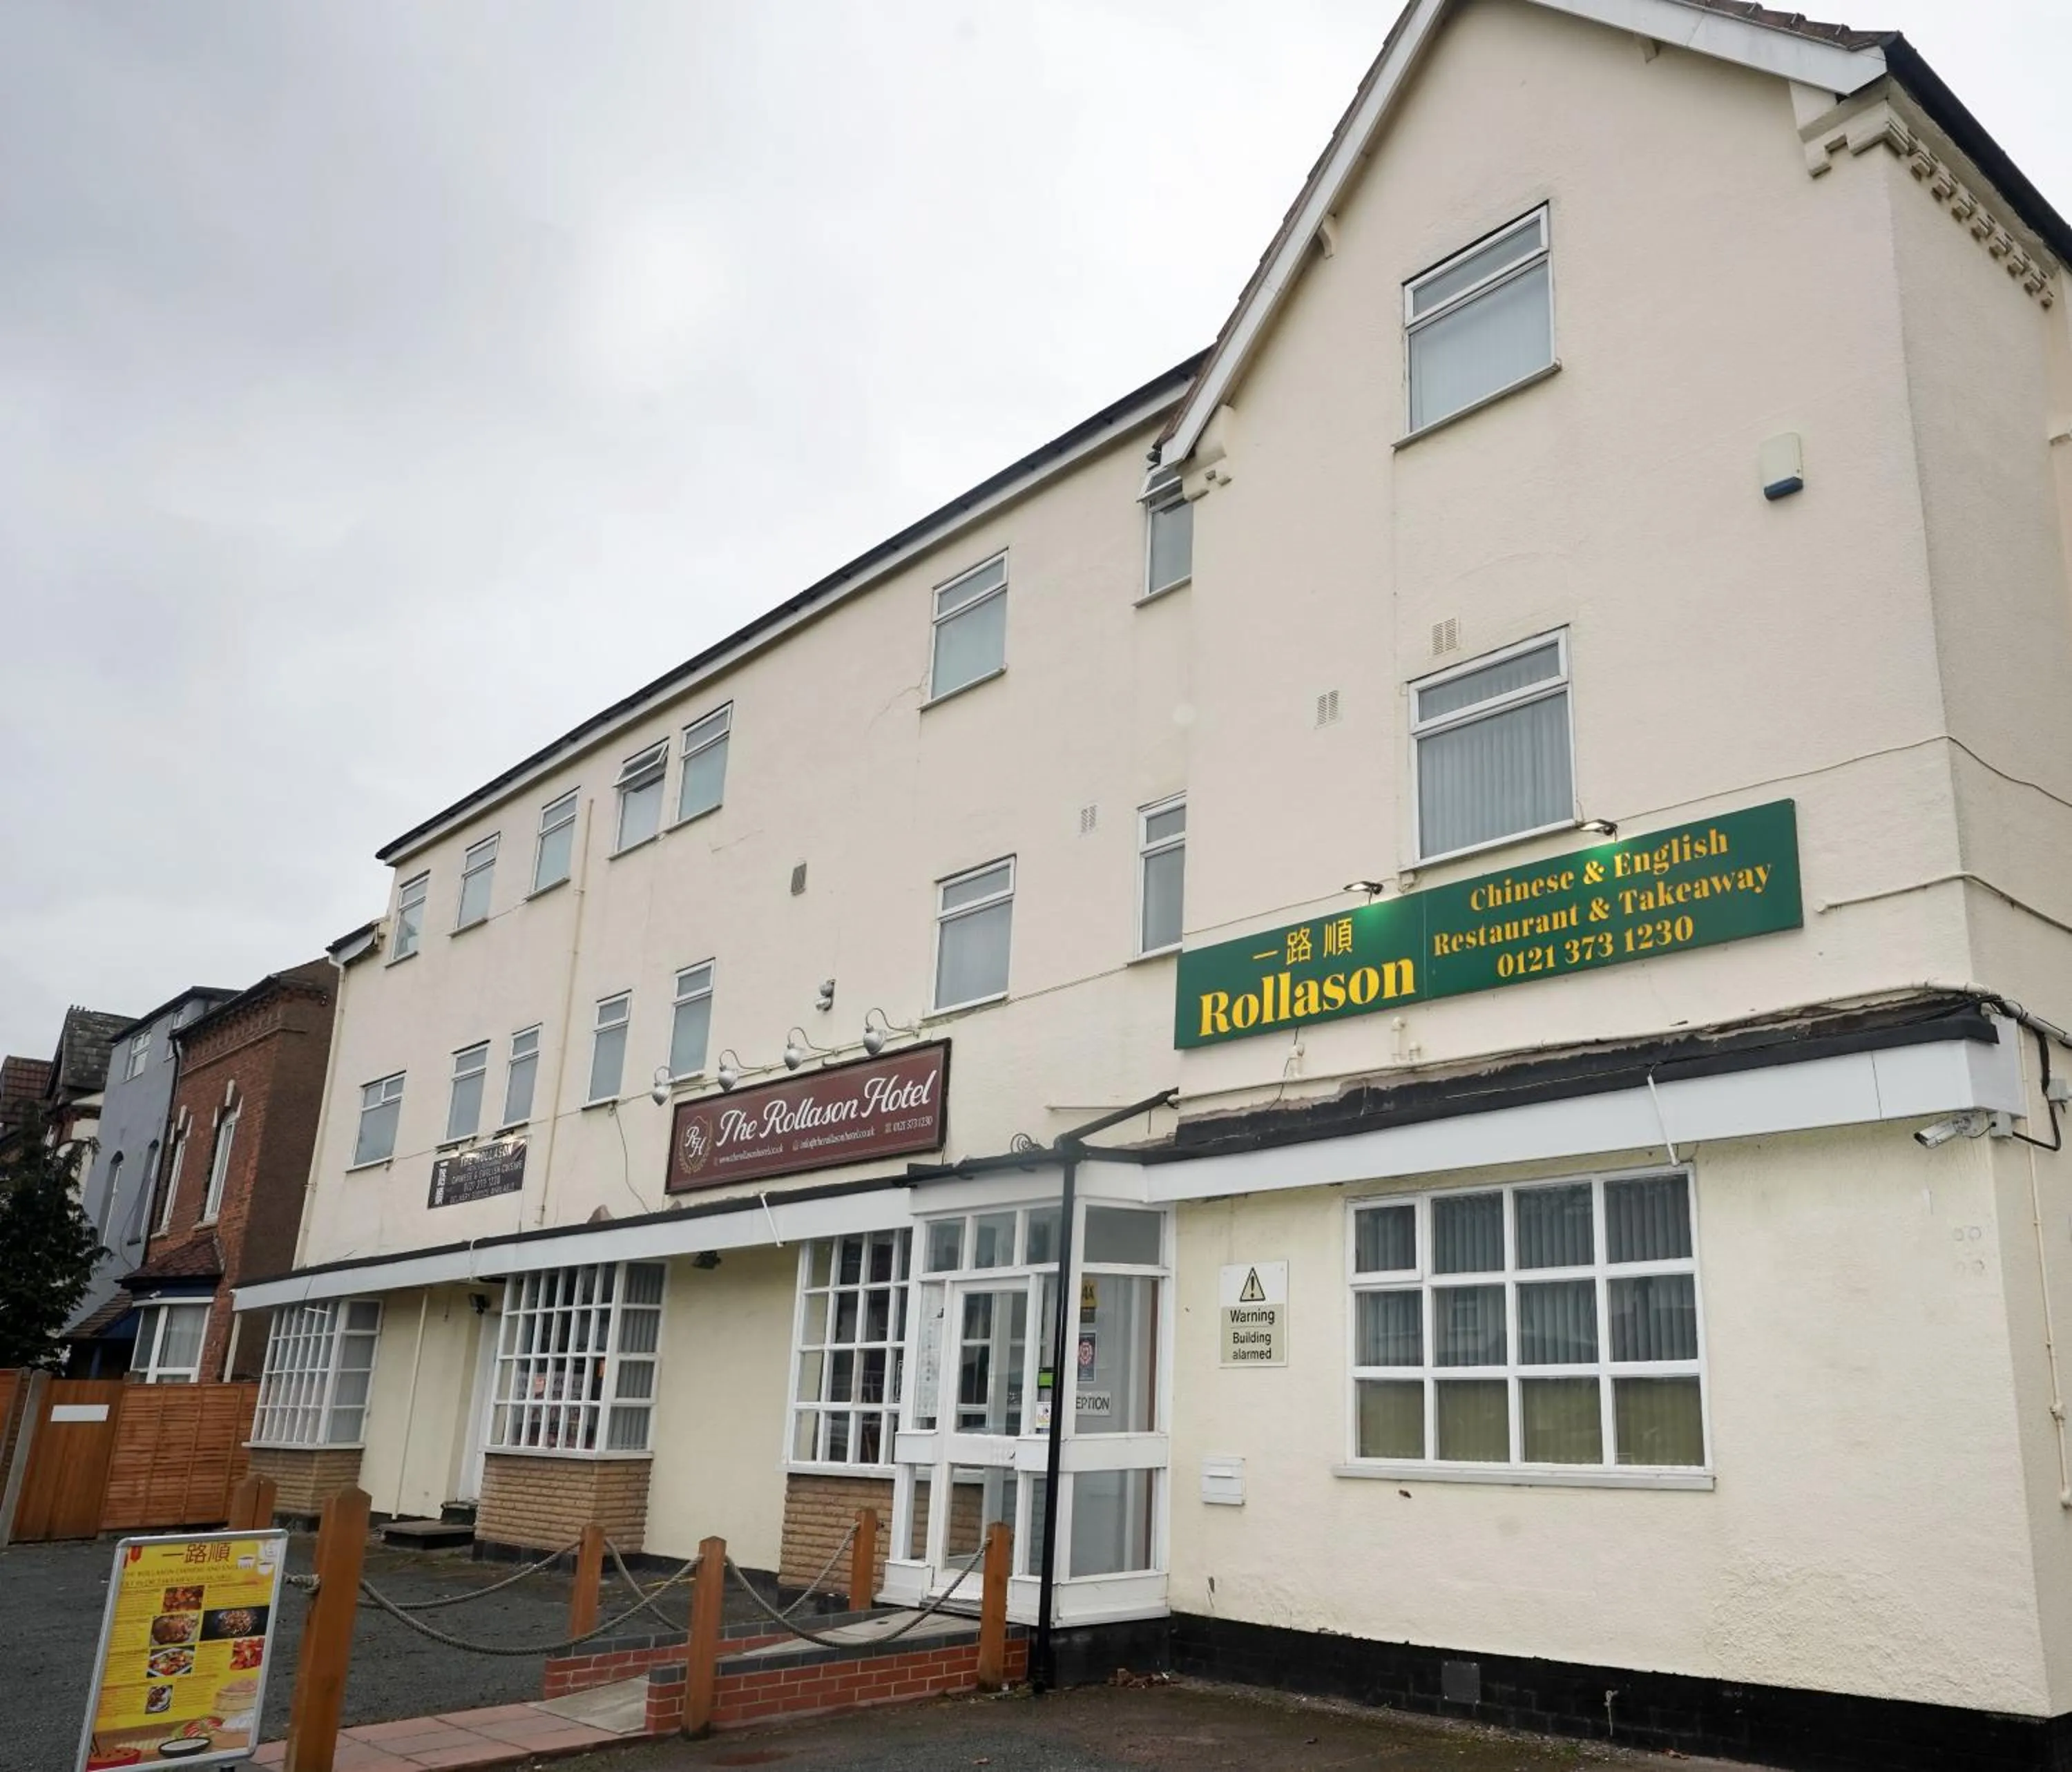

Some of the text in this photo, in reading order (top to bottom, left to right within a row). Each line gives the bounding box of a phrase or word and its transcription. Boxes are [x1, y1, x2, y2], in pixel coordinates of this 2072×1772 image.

[1470, 828, 1729, 912] Chinese & English
[1434, 864, 1772, 957] Restaurant & Takeaway
[1252, 917, 1354, 966] 一路順
[1497, 915, 1694, 979] 0121 373 1230
[1199, 958, 1417, 1037] Rollason
[716, 1070, 938, 1148] The Rollason Hotel
[1230, 1307, 1275, 1325] Warning
[1233, 1331, 1272, 1345] Building
[1232, 1347, 1272, 1360] alarmed
[1075, 1396, 1109, 1410] EPTION
